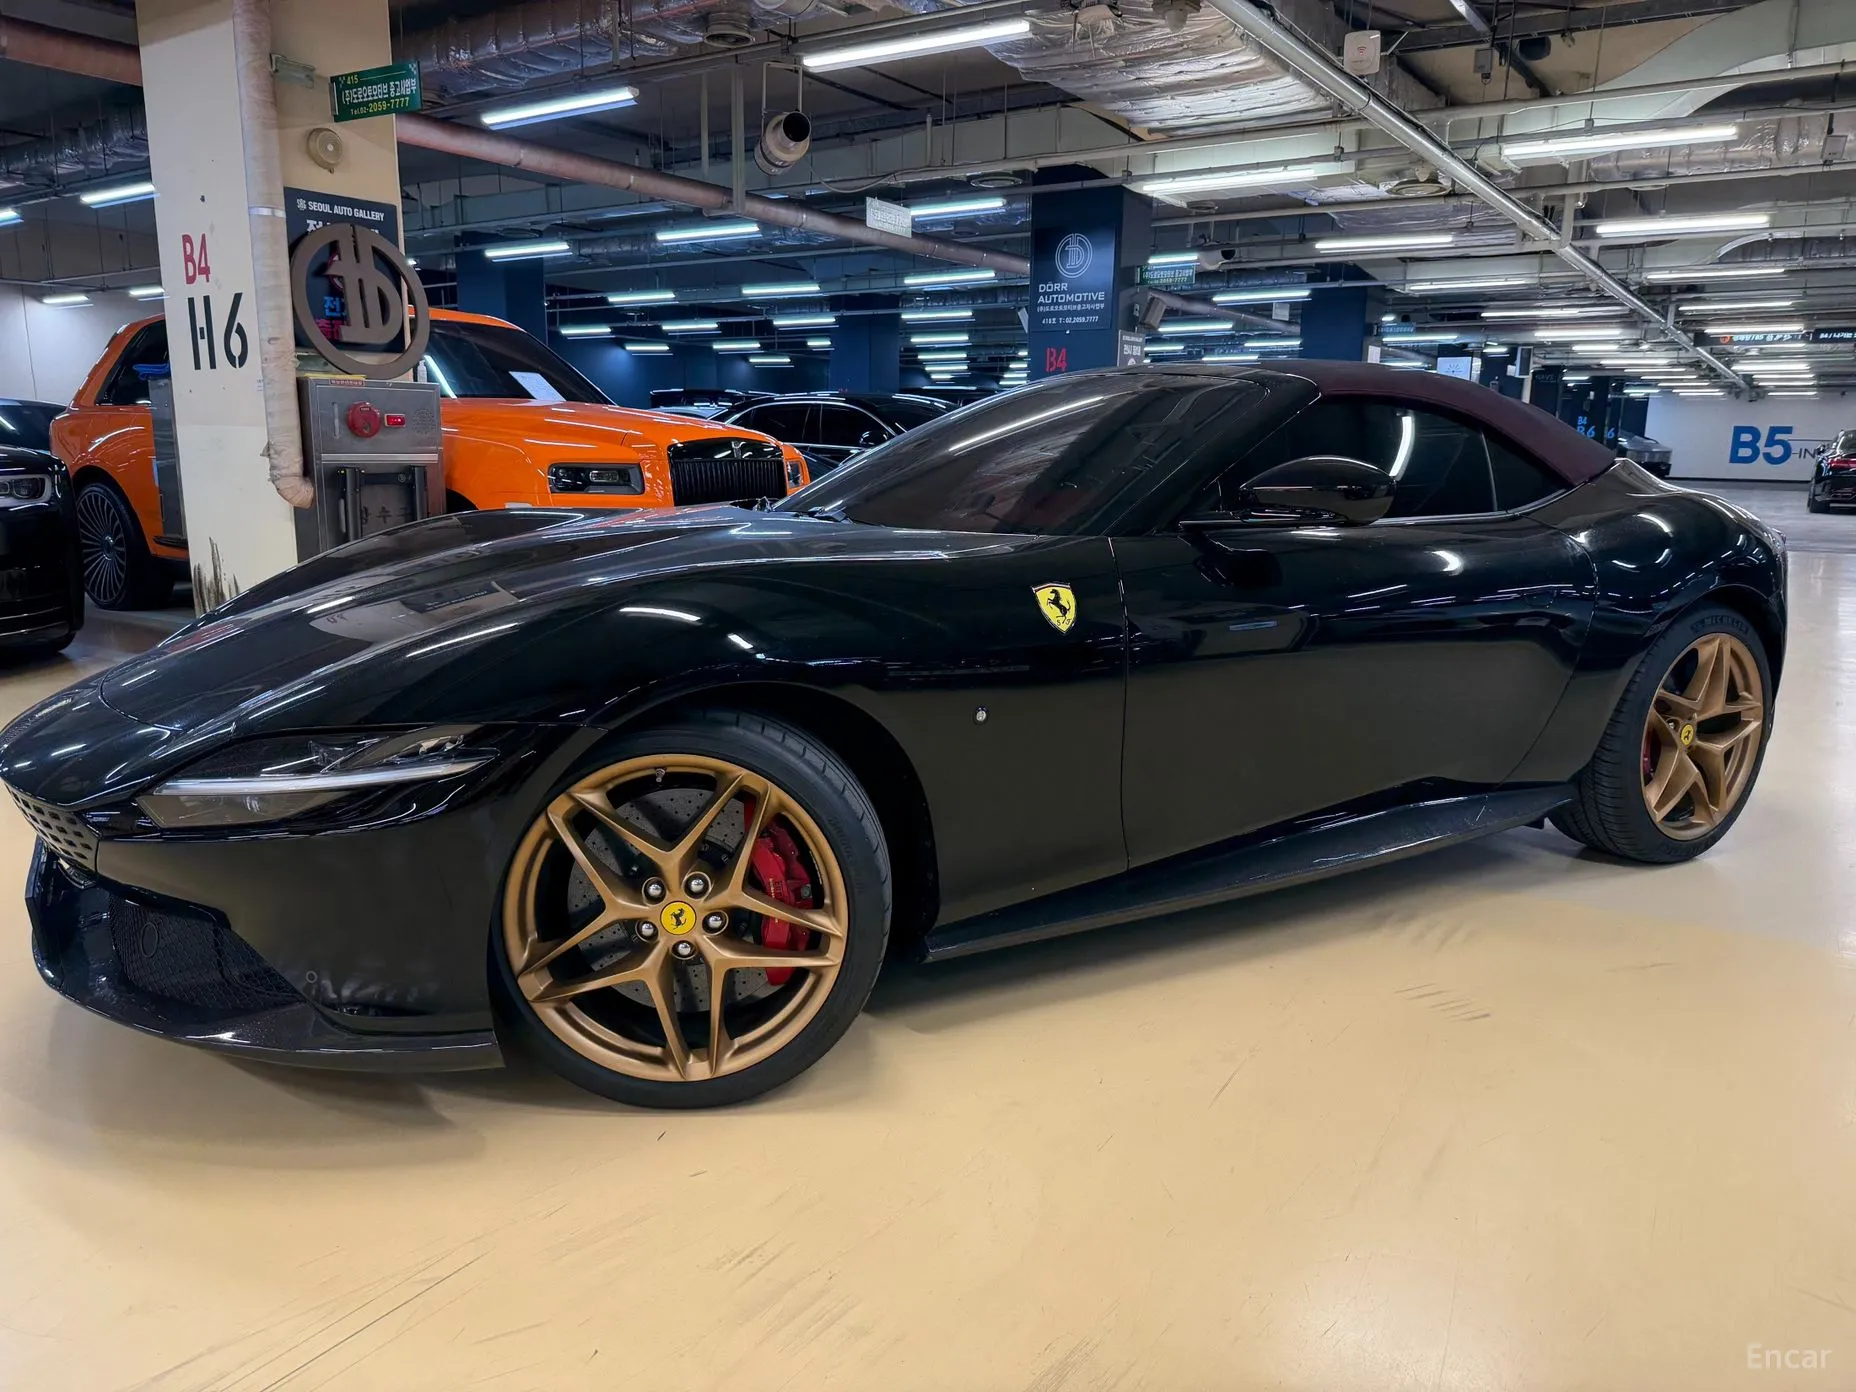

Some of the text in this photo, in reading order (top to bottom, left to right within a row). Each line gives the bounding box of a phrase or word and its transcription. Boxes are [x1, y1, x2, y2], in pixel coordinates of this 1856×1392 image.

[346, 74, 359, 85] 415
[308, 201, 332, 214] SEOUL
[333, 205, 353, 217] AUTO
[354, 209, 385, 222] GALLERY
[182, 233, 211, 285] B4
[1037, 291, 1105, 304] AUTOMOTIVE
[1045, 347, 1067, 372] B4
[1729, 425, 1794, 466] B5
